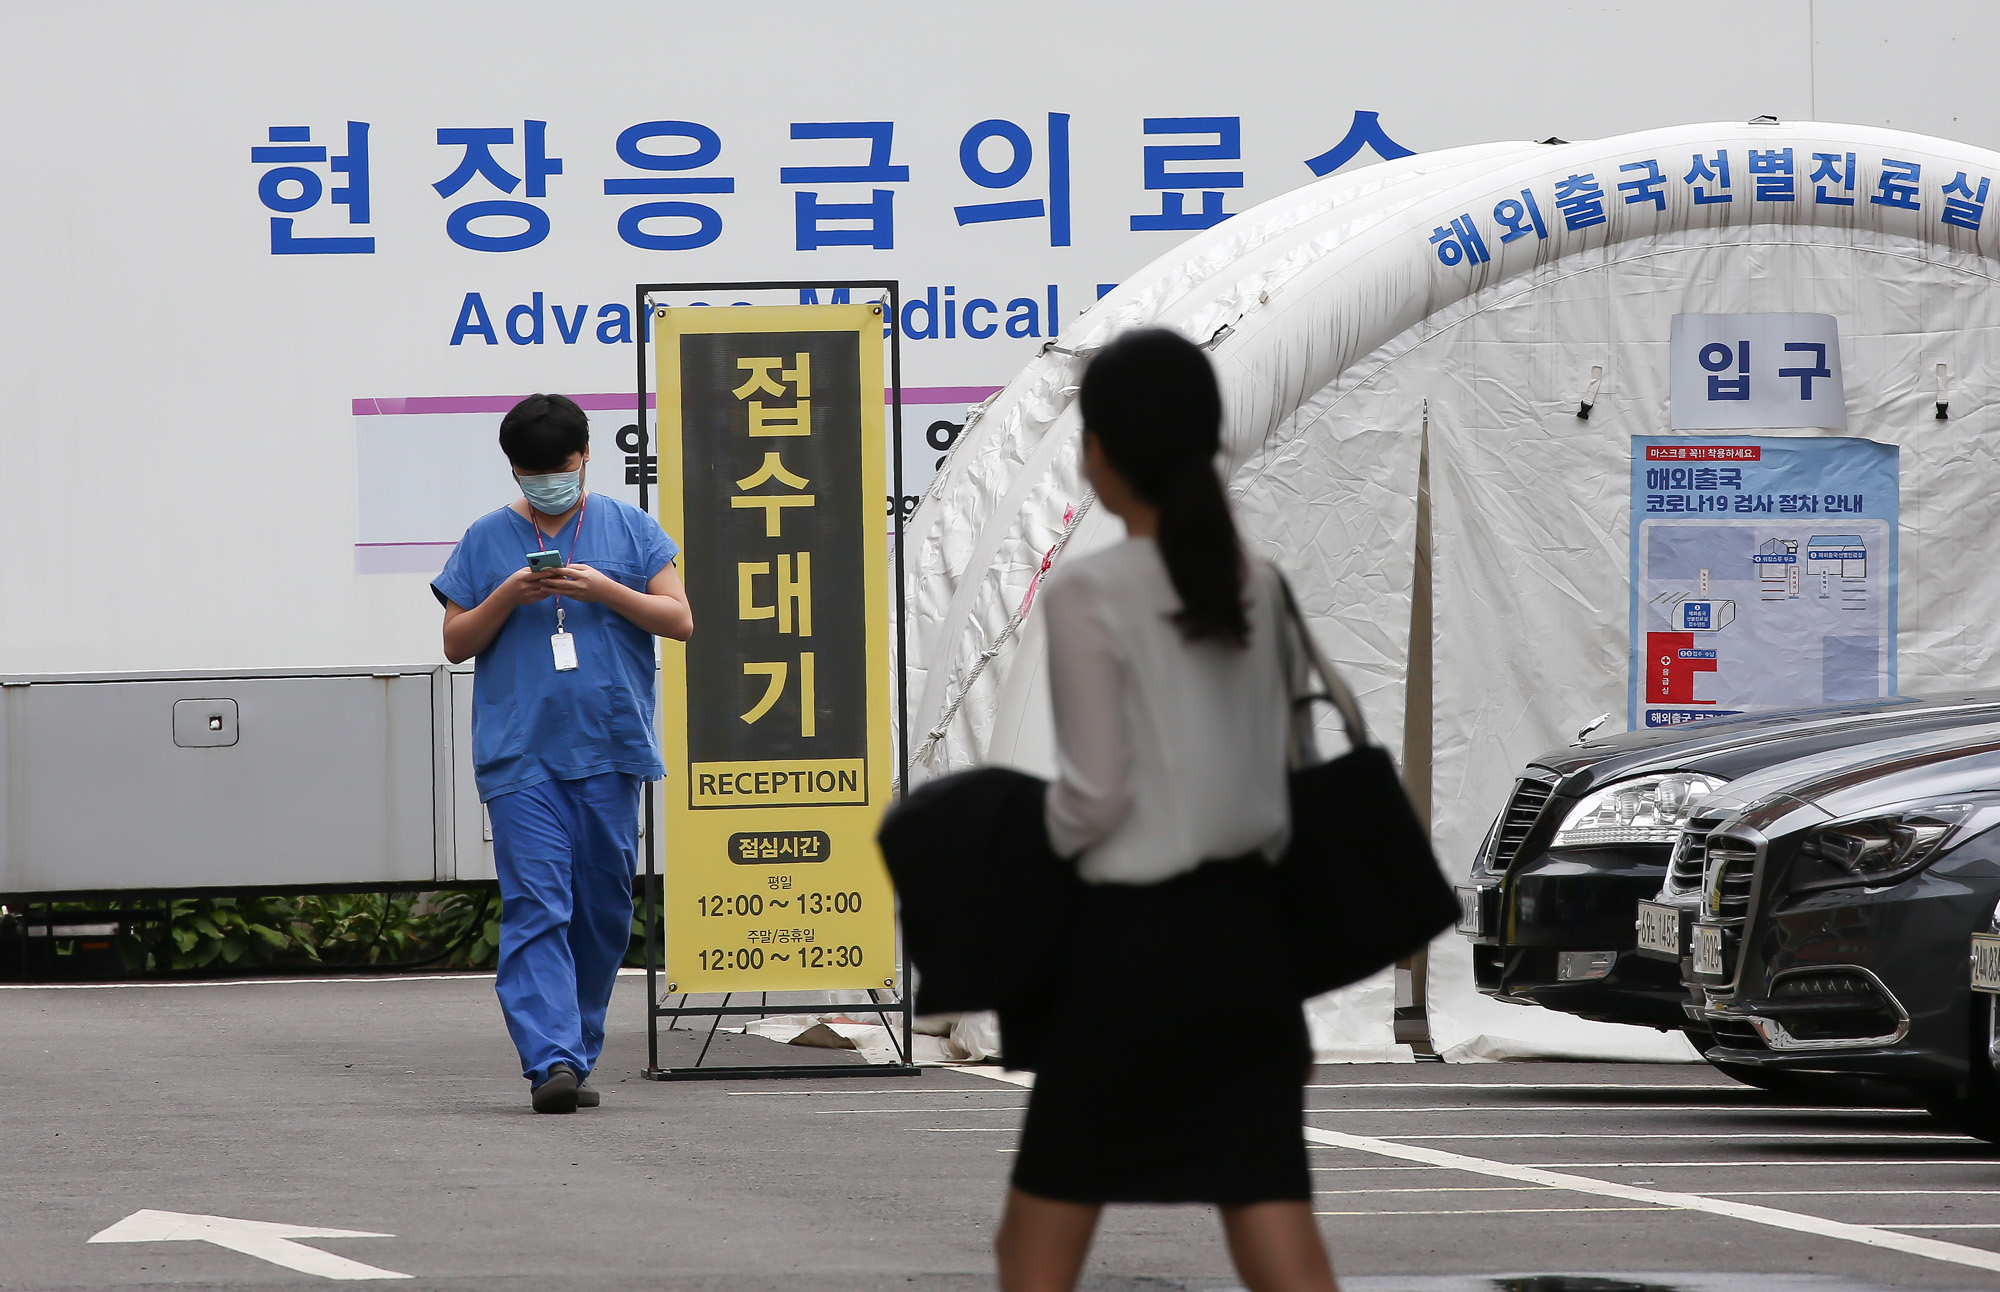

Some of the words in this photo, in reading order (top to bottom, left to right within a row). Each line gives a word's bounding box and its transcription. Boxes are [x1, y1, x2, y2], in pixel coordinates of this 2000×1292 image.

[1699, 341, 1831, 401] 입구
[1650, 448, 1686, 459] 마스크를
[1689, 448, 1705, 459] 꼭!!
[1707, 448, 1756, 460] 착용하세요.
[1646, 467, 1743, 491] 해외출국
[1646, 494, 1728, 513] 코로나19
[1734, 494, 1773, 513] 검사
[1779, 494, 1819, 513] 절차
[1824, 494, 1863, 513] 안내
[731, 352, 816, 738] 접수대기
[699, 770, 858, 796] RECEPTION
[738, 836, 821, 859] 점심시간
[767, 875, 792, 891] 평일
[697, 894, 764, 917] 12:00
[796, 891, 863, 915] 13:00
[746, 928, 816, 944] 주말/공휴일
[698, 948, 764, 971] 12:00
[797, 945, 864, 968] 12:30
